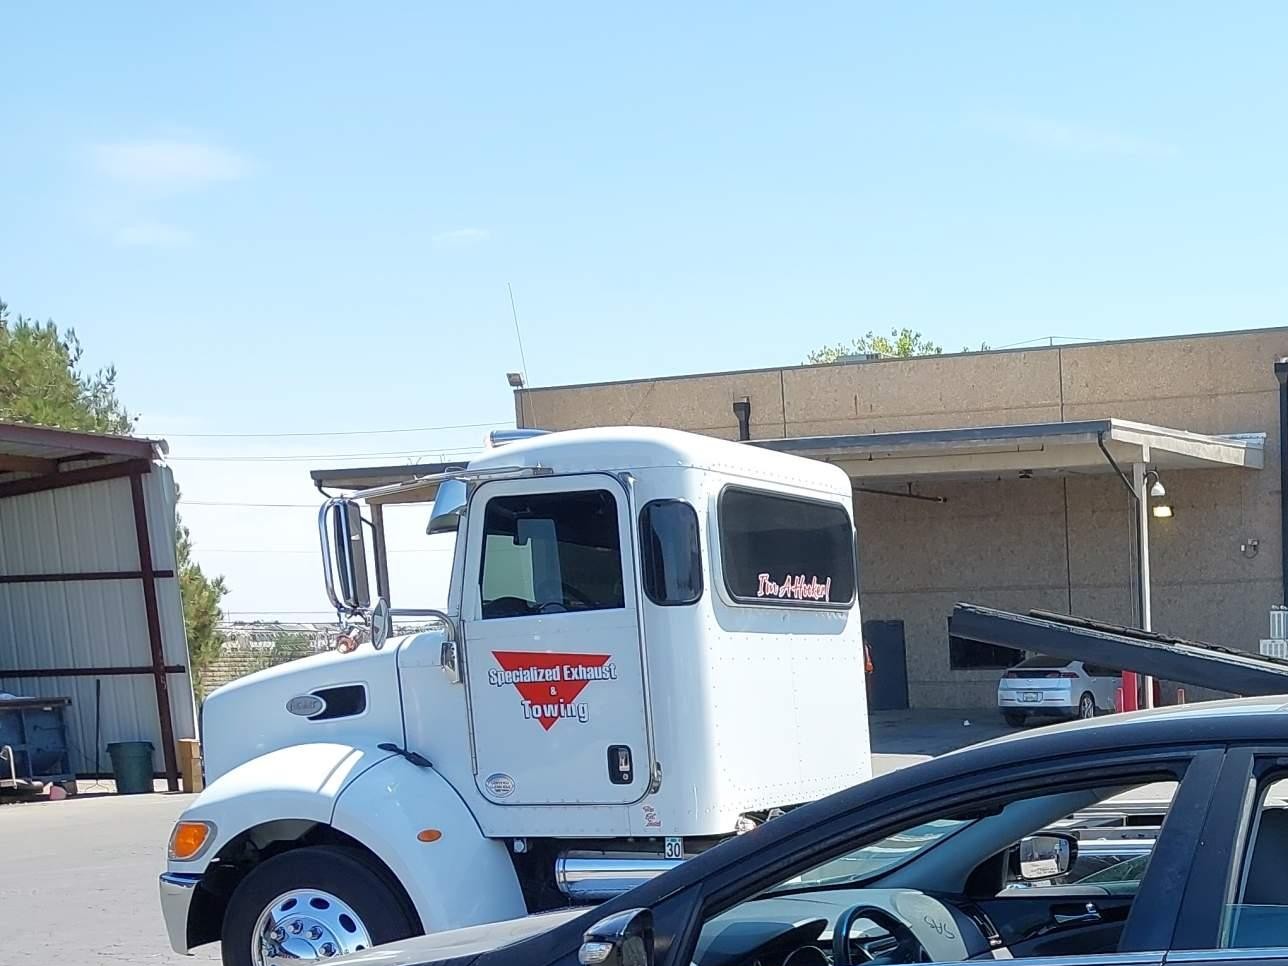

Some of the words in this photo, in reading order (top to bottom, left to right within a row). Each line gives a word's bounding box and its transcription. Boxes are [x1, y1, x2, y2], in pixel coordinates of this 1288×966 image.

[757, 573, 779, 597] I'm
[779, 574, 792, 598] A
[488, 667, 561, 687] Specialized
[562, 663, 618, 681] Exhaust
[550, 686, 557, 696] &
[521, 699, 589, 722] Towing
[666, 842, 681, 858] 30
